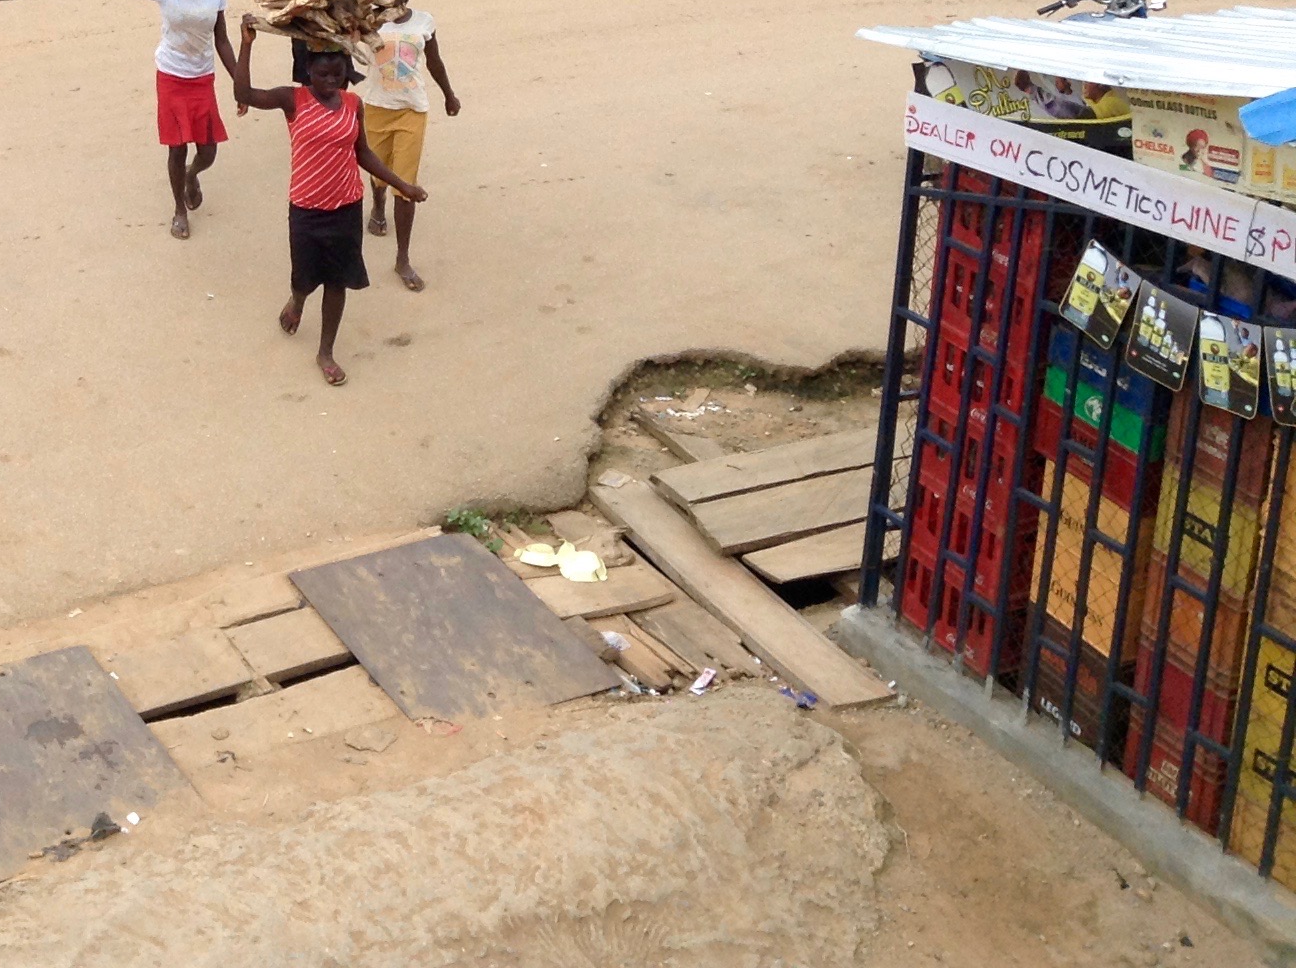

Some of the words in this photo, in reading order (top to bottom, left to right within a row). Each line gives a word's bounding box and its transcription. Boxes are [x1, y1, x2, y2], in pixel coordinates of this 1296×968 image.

[1156, 100, 1183, 113] GLASS
[1184, 104, 1217, 120] BOTTLES
[1134, 139, 1176, 155] CHELSEA
[905, 115, 976, 151] DEALER
[990, 138, 1022, 163] ON
[1025, 150, 1167, 222] COSMETICS
[1171, 201, 1240, 242] WINE
